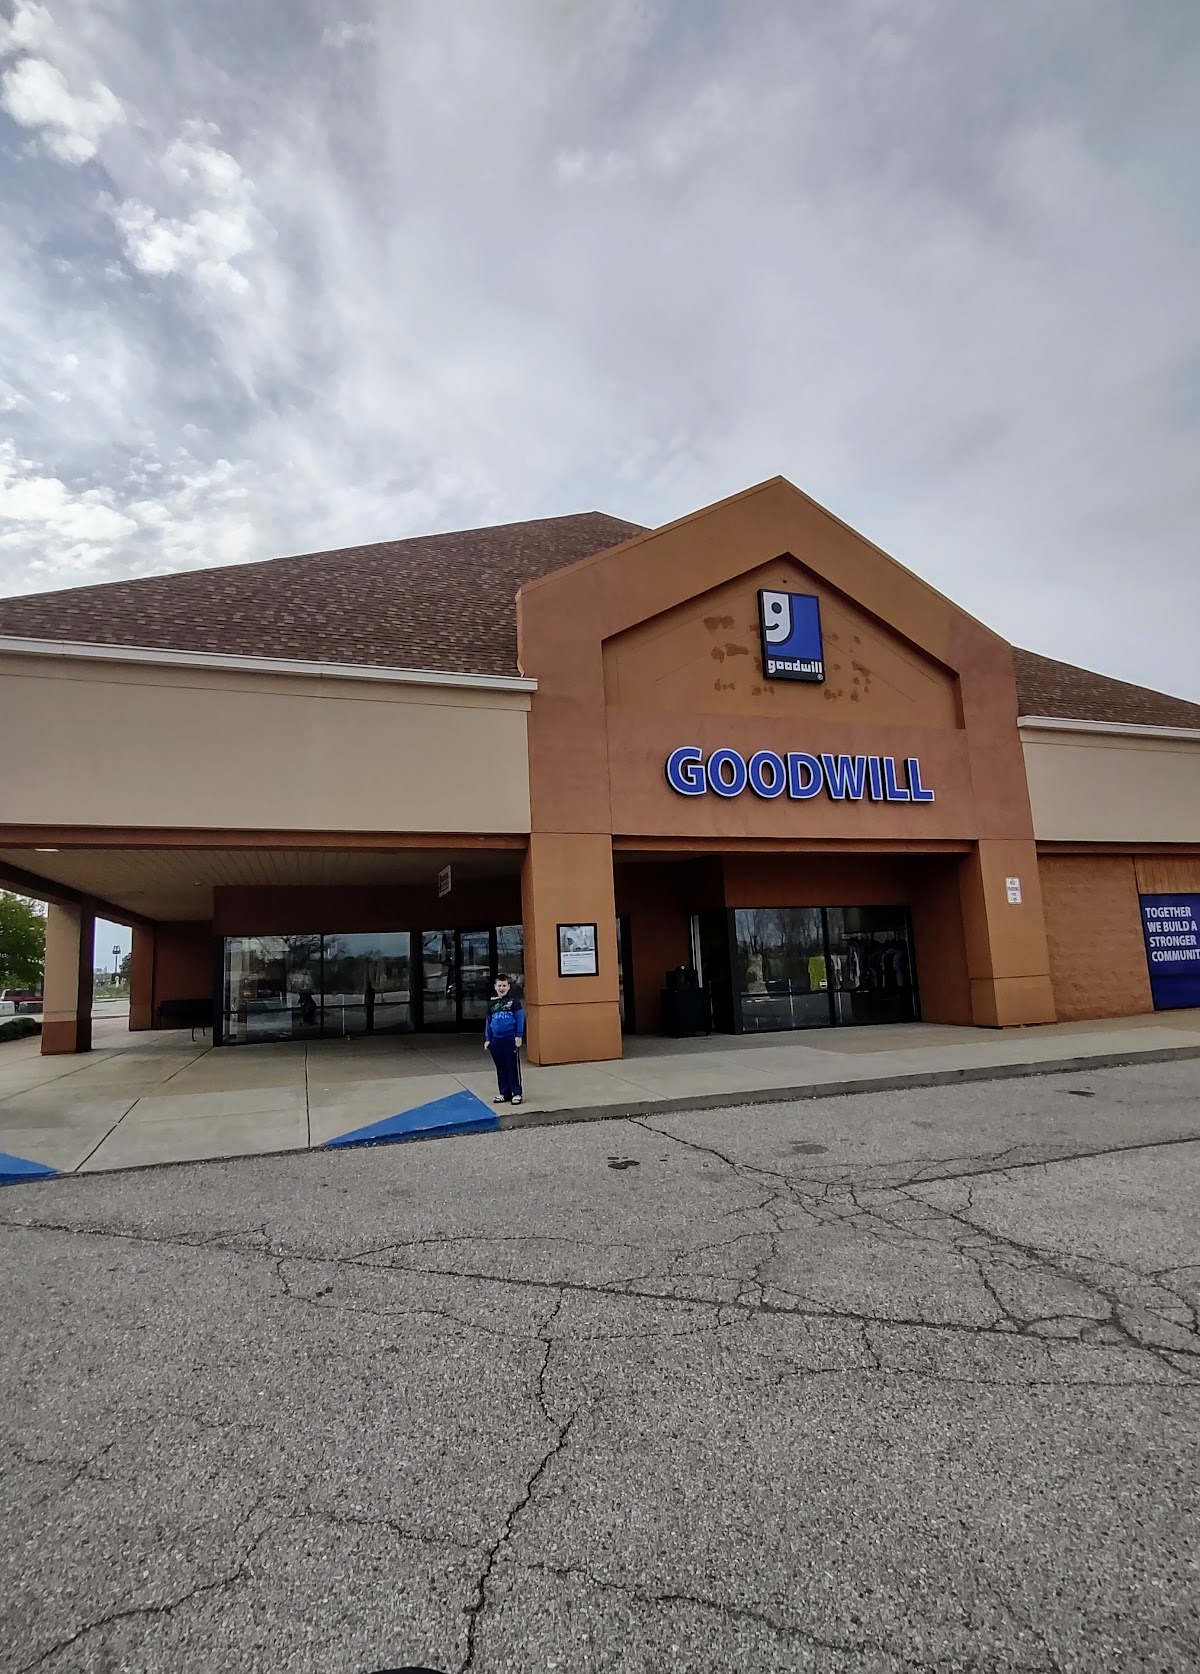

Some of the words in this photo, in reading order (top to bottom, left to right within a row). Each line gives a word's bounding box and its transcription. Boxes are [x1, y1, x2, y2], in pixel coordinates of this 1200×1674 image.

[767, 659, 823, 674] goodwill
[665, 746, 936, 802] GOODWILL
[1144, 906, 1192, 919] TOGETHER
[1146, 921, 1163, 933] WE
[1162, 920, 1190, 932] BUILD
[1191, 920, 1198, 932] A
[1149, 934, 1197, 948] STRONGER
